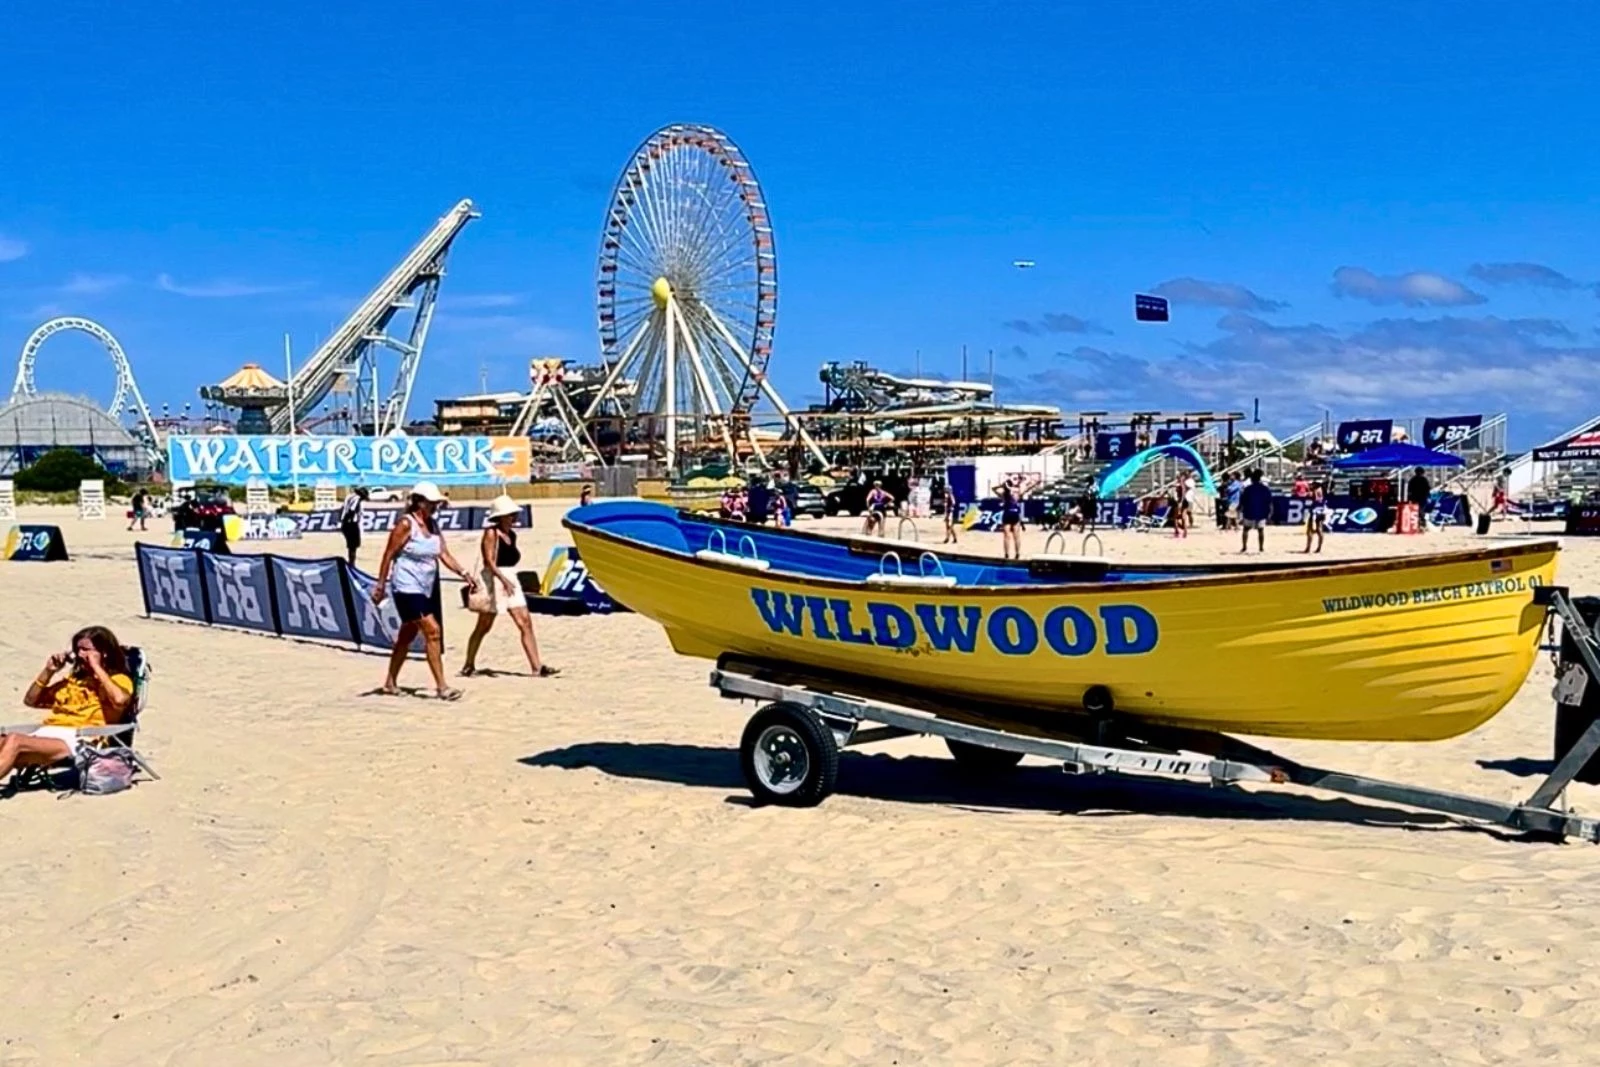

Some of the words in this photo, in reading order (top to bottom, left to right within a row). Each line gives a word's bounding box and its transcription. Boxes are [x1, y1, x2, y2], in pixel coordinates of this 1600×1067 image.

[1360, 429, 1383, 444] BFL
[177, 439, 357, 475] WATER
[370, 437, 499, 475] PARK
[1323, 592, 1408, 613] WILDWOOD
[1413, 585, 1462, 604] BEACH
[1466, 577, 1526, 597] PATROL
[1529, 575, 1543, 589] 01
[750, 587, 1159, 656] WILDWOOD
